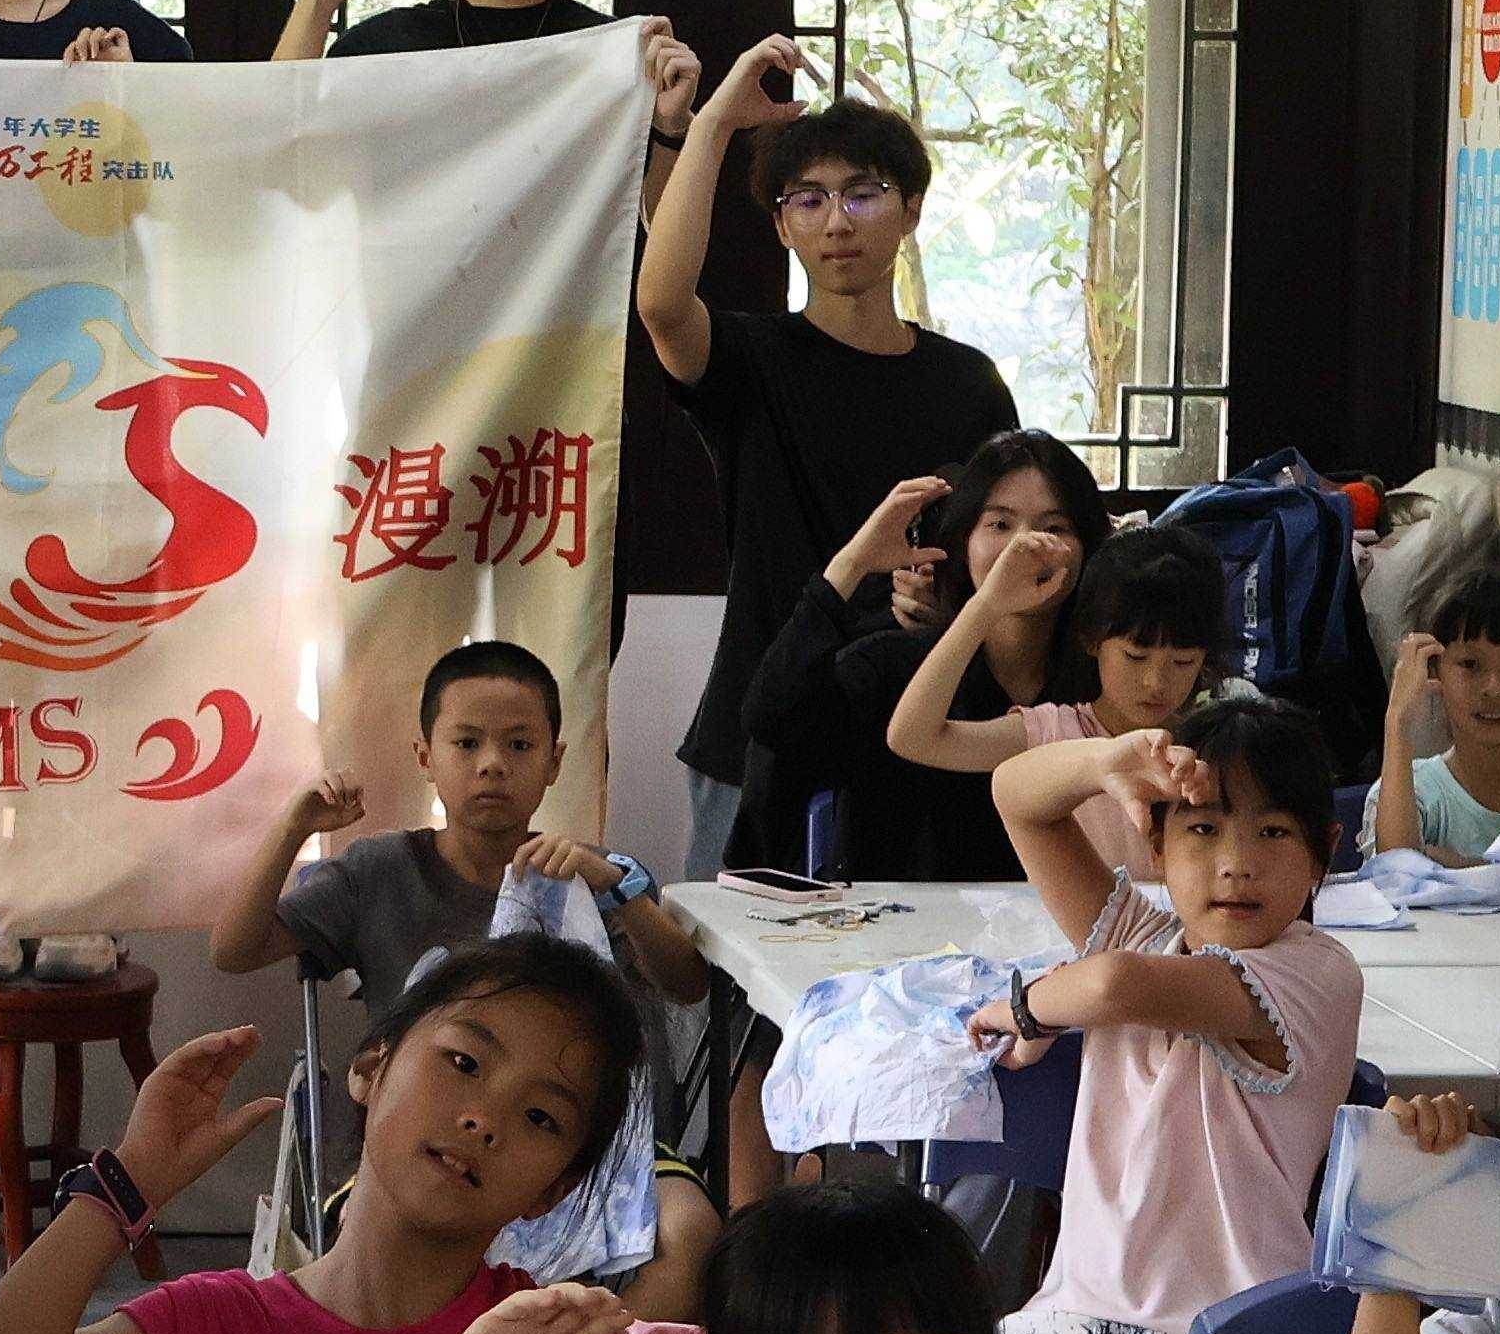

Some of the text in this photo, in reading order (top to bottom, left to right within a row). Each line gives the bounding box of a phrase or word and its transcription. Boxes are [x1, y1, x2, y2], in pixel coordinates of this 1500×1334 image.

[102, 159, 177, 182] 突击队
[333, 425, 596, 585] 漫溯
